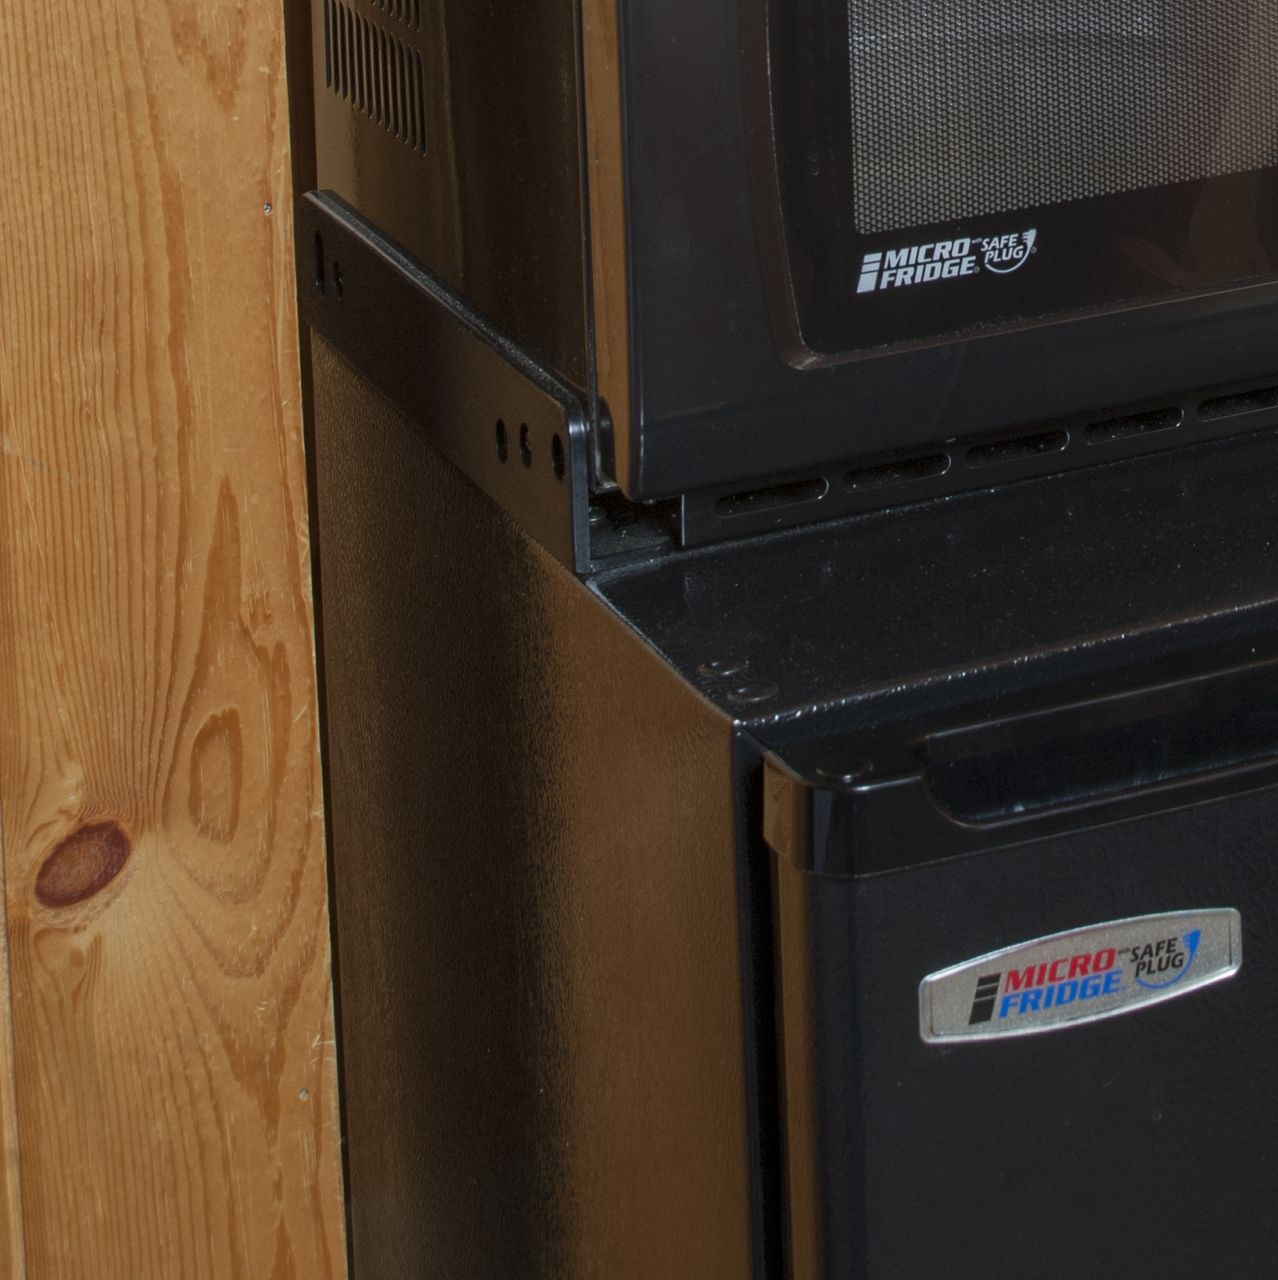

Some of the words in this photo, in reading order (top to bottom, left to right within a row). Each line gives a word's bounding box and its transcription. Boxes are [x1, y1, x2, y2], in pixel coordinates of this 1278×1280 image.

[879, 256, 977, 290] FRIDGE
[984, 245, 1024, 264] PLUG
[884, 237, 971, 270] MICRO
[981, 233, 1019, 252] SAFE
[999, 969, 1123, 1019] FRIDGE
[1134, 952, 1185, 978] PLUG
[1005, 948, 1117, 993] MICRO
[1130, 937, 1178, 963] SAFE
